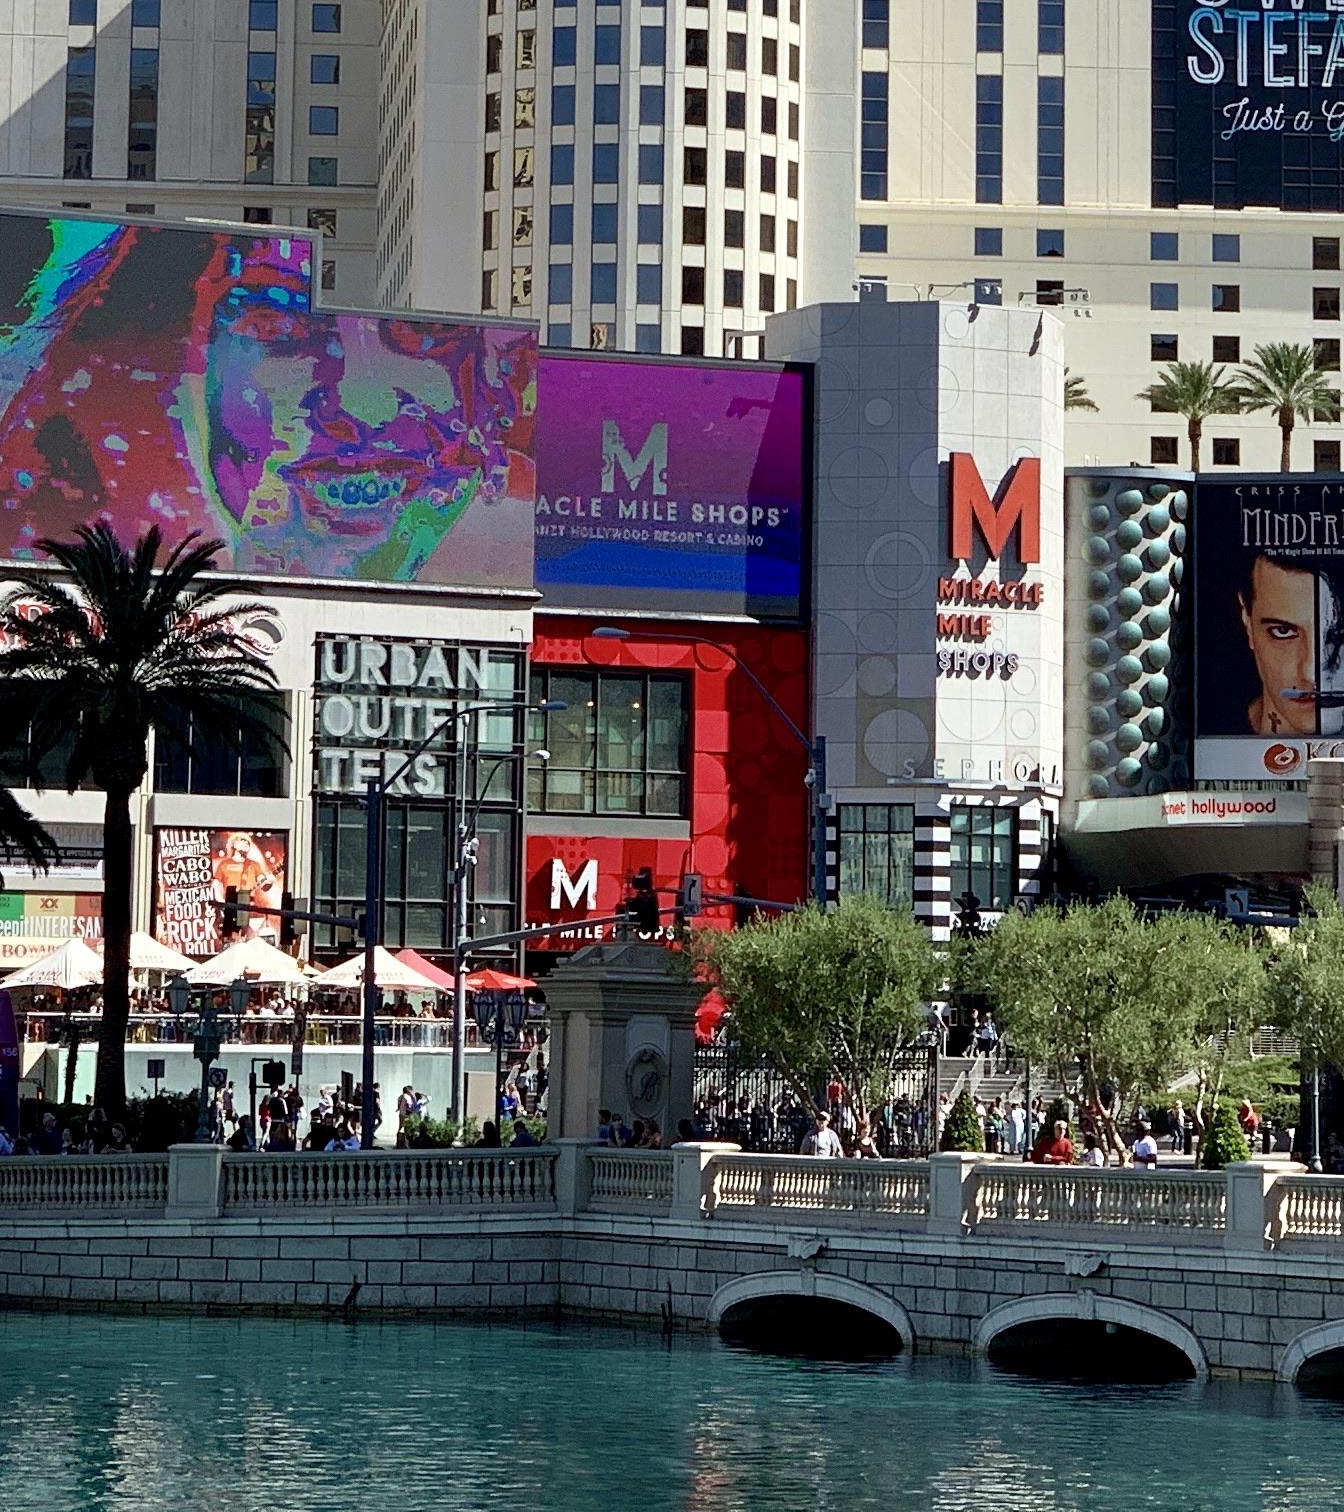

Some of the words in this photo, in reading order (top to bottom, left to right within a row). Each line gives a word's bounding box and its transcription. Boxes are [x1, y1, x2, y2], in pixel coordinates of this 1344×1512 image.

[1221, 97, 1285, 140] Just
[1293, 111, 1313, 131] a
[601, 419, 669, 496] M
[1234, 485, 1301, 496] CRISS
[618, 499, 678, 522] MILE
[691, 503, 780, 527] SHOPS
[948, 452, 1041, 564] M
[570, 526, 650, 541] HOLLYWOOD
[653, 530, 702, 545] RESORT
[718, 534, 764, 547] CASINO
[938, 577, 1045, 604] MIRACLE
[938, 614, 992, 638] MILE
[323, 640, 489, 690] URBAN
[939, 649, 1020, 674] SHOPS
[322, 694, 497, 743] OUTFIT
[321, 749, 438, 795] TERS
[1191, 797, 1277, 819] hollywood
[160, 829, 210, 848] KILLER
[161, 844, 211, 858] MARGARITAS
[163, 857, 211, 874] CABO
[164, 870, 212, 886] WABO
[550, 858, 599, 910] M
[165, 888, 215, 906] MEXICAN
[166, 902, 202, 921] FOOD
[205, 903, 216, 918] &
[167, 918, 218, 944] ROCK
[560, 924, 604, 939] MILE
[185, 940, 220, 955] ROLL
